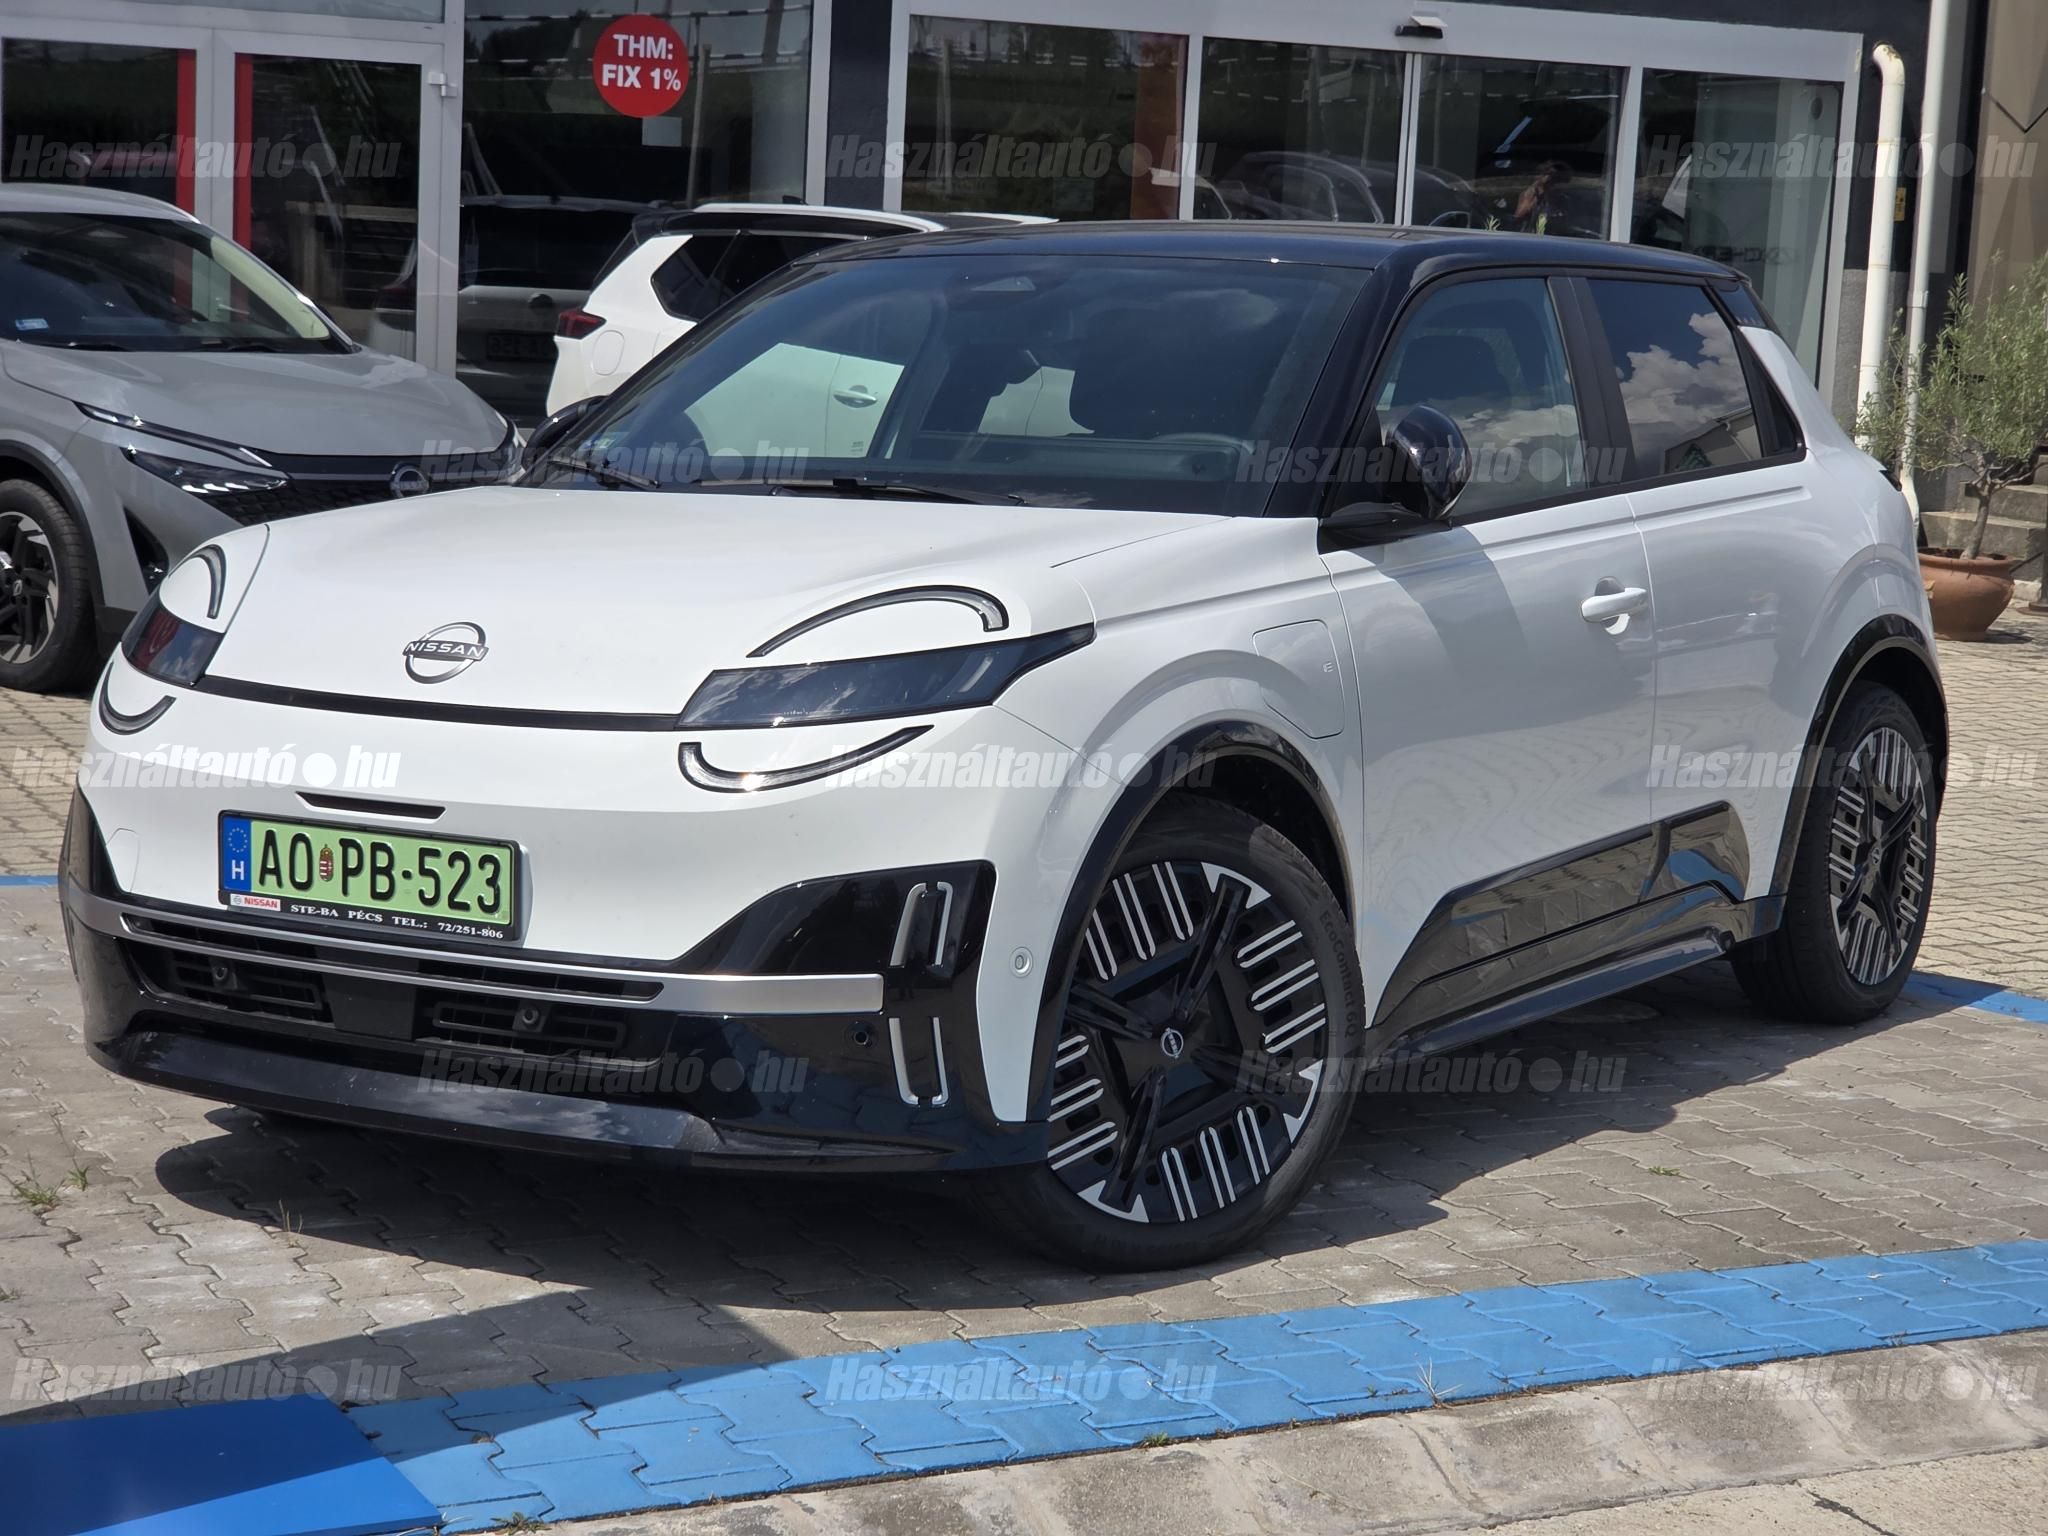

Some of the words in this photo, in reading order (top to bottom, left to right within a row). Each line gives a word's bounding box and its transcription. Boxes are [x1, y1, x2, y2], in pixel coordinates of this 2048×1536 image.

[612, 33, 674, 60] THM:
[602, 63, 642, 89] FIX
[649, 67, 682, 92] 1%
[405, 641, 485, 658] NISSAN
[230, 859, 246, 881] H
[338, 837, 502, 914] PB-523
[244, 896, 278, 909] NISSAN
[290, 903, 339, 918] STE-BA
[348, 908, 384, 924] PÉCS
[391, 915, 428, 929] TEL.:
[438, 922, 504, 939] 72/251-806
